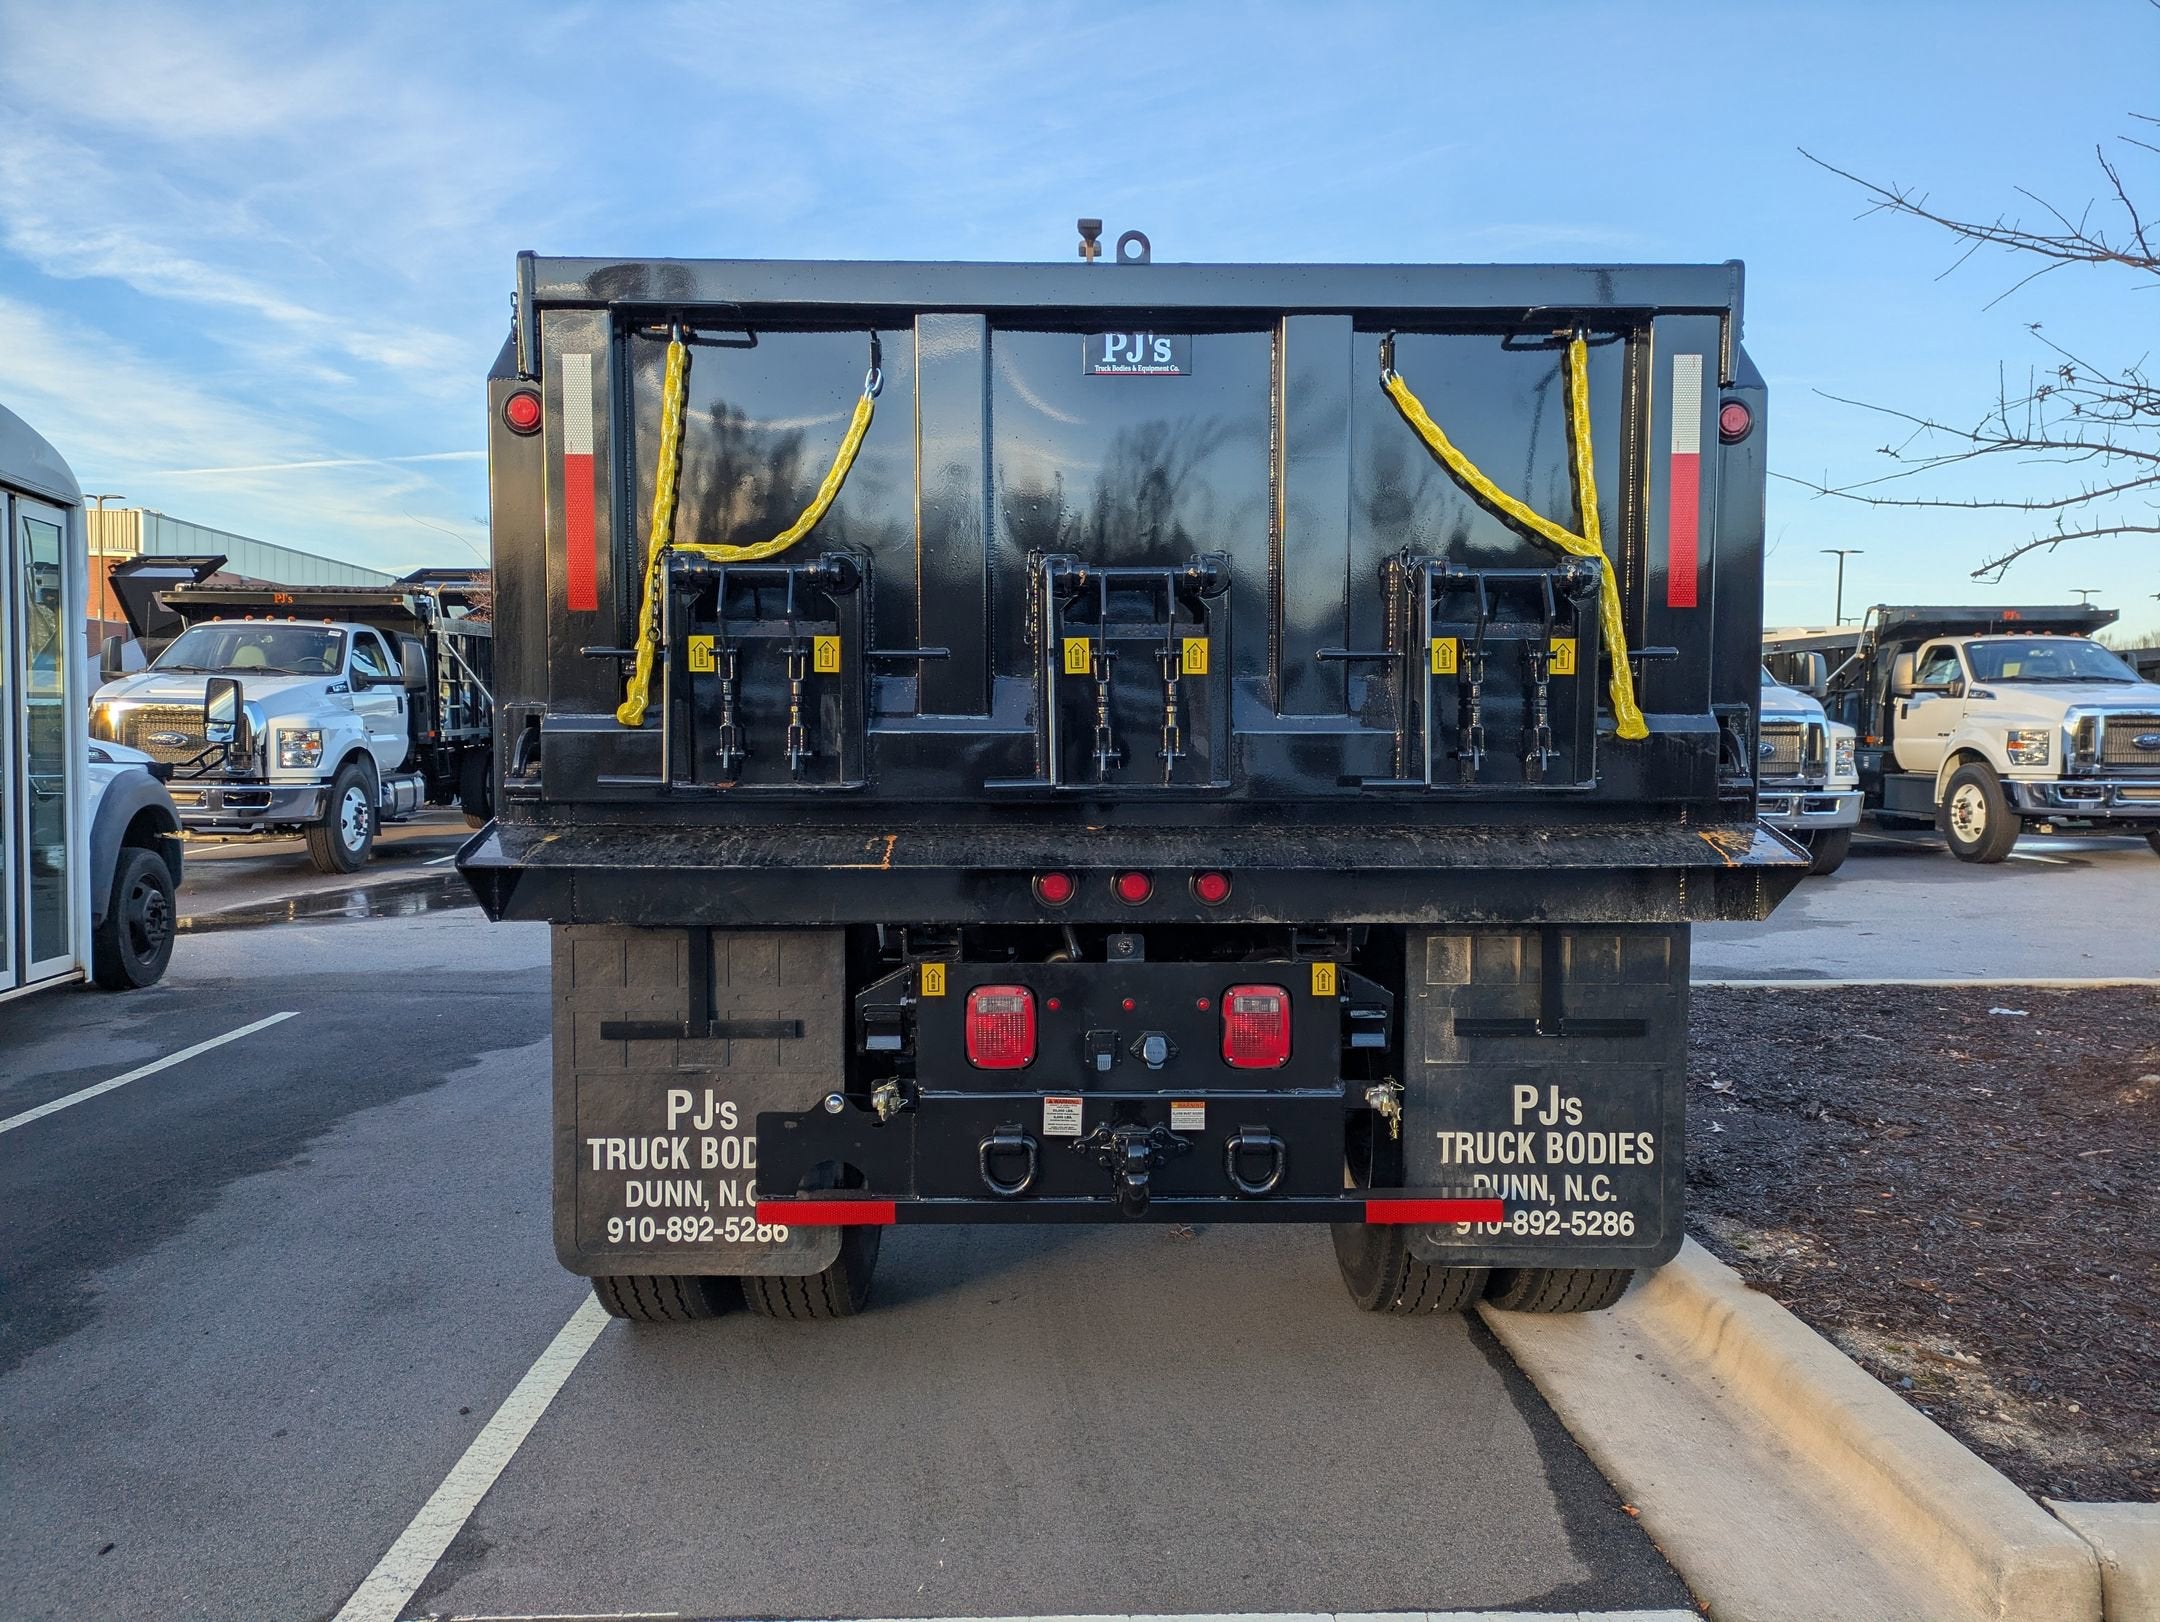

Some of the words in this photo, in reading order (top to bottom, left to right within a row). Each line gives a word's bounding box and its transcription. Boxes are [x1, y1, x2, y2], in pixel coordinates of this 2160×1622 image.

[1102, 333, 1172, 363] PJ's
[1094, 364, 1112, 372] Truck
[1112, 364, 1131, 372] Bodies
[1132, 364, 1137, 372] &
[1138, 364, 1169, 374] Equipment
[1170, 364, 1180, 372] Co.
[274, 592, 294, 604] PJ's
[667, 1089, 738, 1131] PJ's
[1514, 1084, 1583, 1126] PJ's
[586, 1137, 691, 1171] TRUCK
[701, 1136, 757, 1170] BOD
[1436, 1131, 1536, 1164] TRUCK
[1546, 1131, 1655, 1165] BODIES
[626, 1180, 710, 1213] DUNN,
[719, 1180, 757, 1208] N.C
[1564, 1174, 1617, 1202] N.C.
[607, 1216, 789, 1243] 910-892-5286
